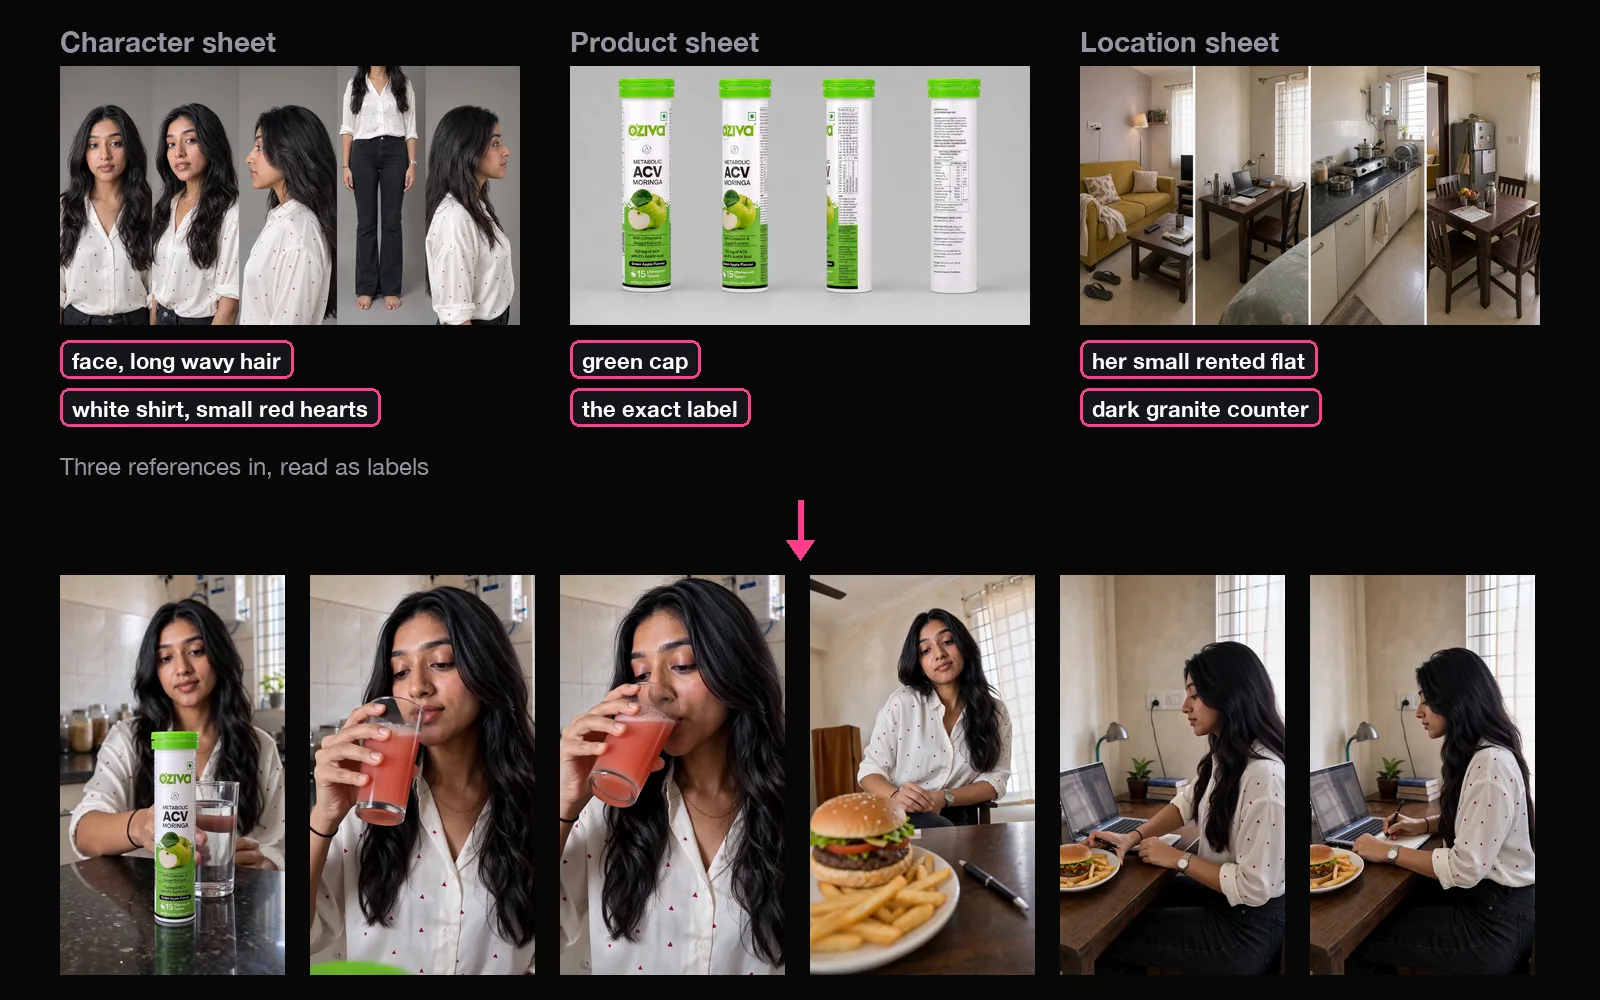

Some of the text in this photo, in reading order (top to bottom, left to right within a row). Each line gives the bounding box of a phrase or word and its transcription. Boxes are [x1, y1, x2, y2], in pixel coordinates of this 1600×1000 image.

[633, 165, 663, 178] ACV
[724, 166, 750, 178] ACV
[637, 270, 646, 278] 15
[162, 811, 188, 822] ACV
